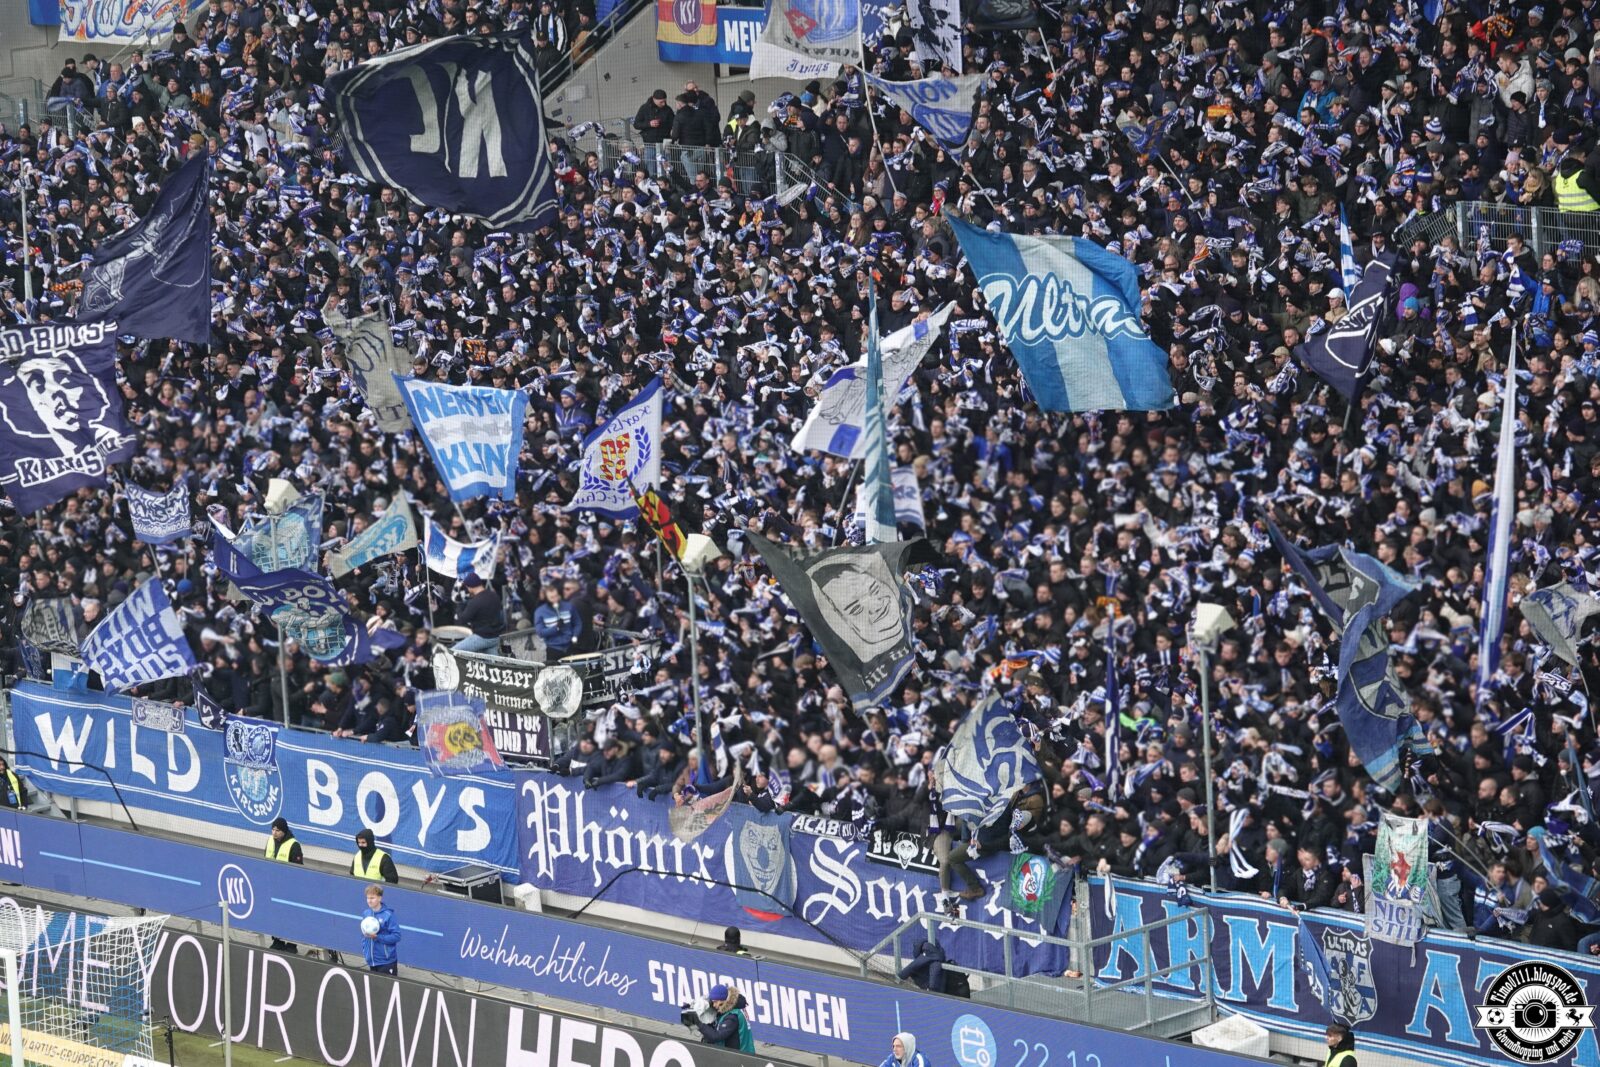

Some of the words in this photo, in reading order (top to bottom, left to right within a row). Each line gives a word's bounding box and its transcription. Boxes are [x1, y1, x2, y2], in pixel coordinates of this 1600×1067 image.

[411, 386, 515, 424] NERVEN
[465, 660, 533, 689] Moser
[493, 690, 534, 710] immer
[493, 728, 522, 753] UND
[34, 711, 201, 793] WILD
[306, 758, 491, 852] BOYS
[792, 813, 840, 836] ACAB
[225, 875, 247, 906] KSC
[460, 923, 638, 997] Weihnachtliches
[1326, 935, 1368, 958] ULTRAS
[131, 930, 296, 1056] YOUR
[316, 966, 477, 1067] OWN
